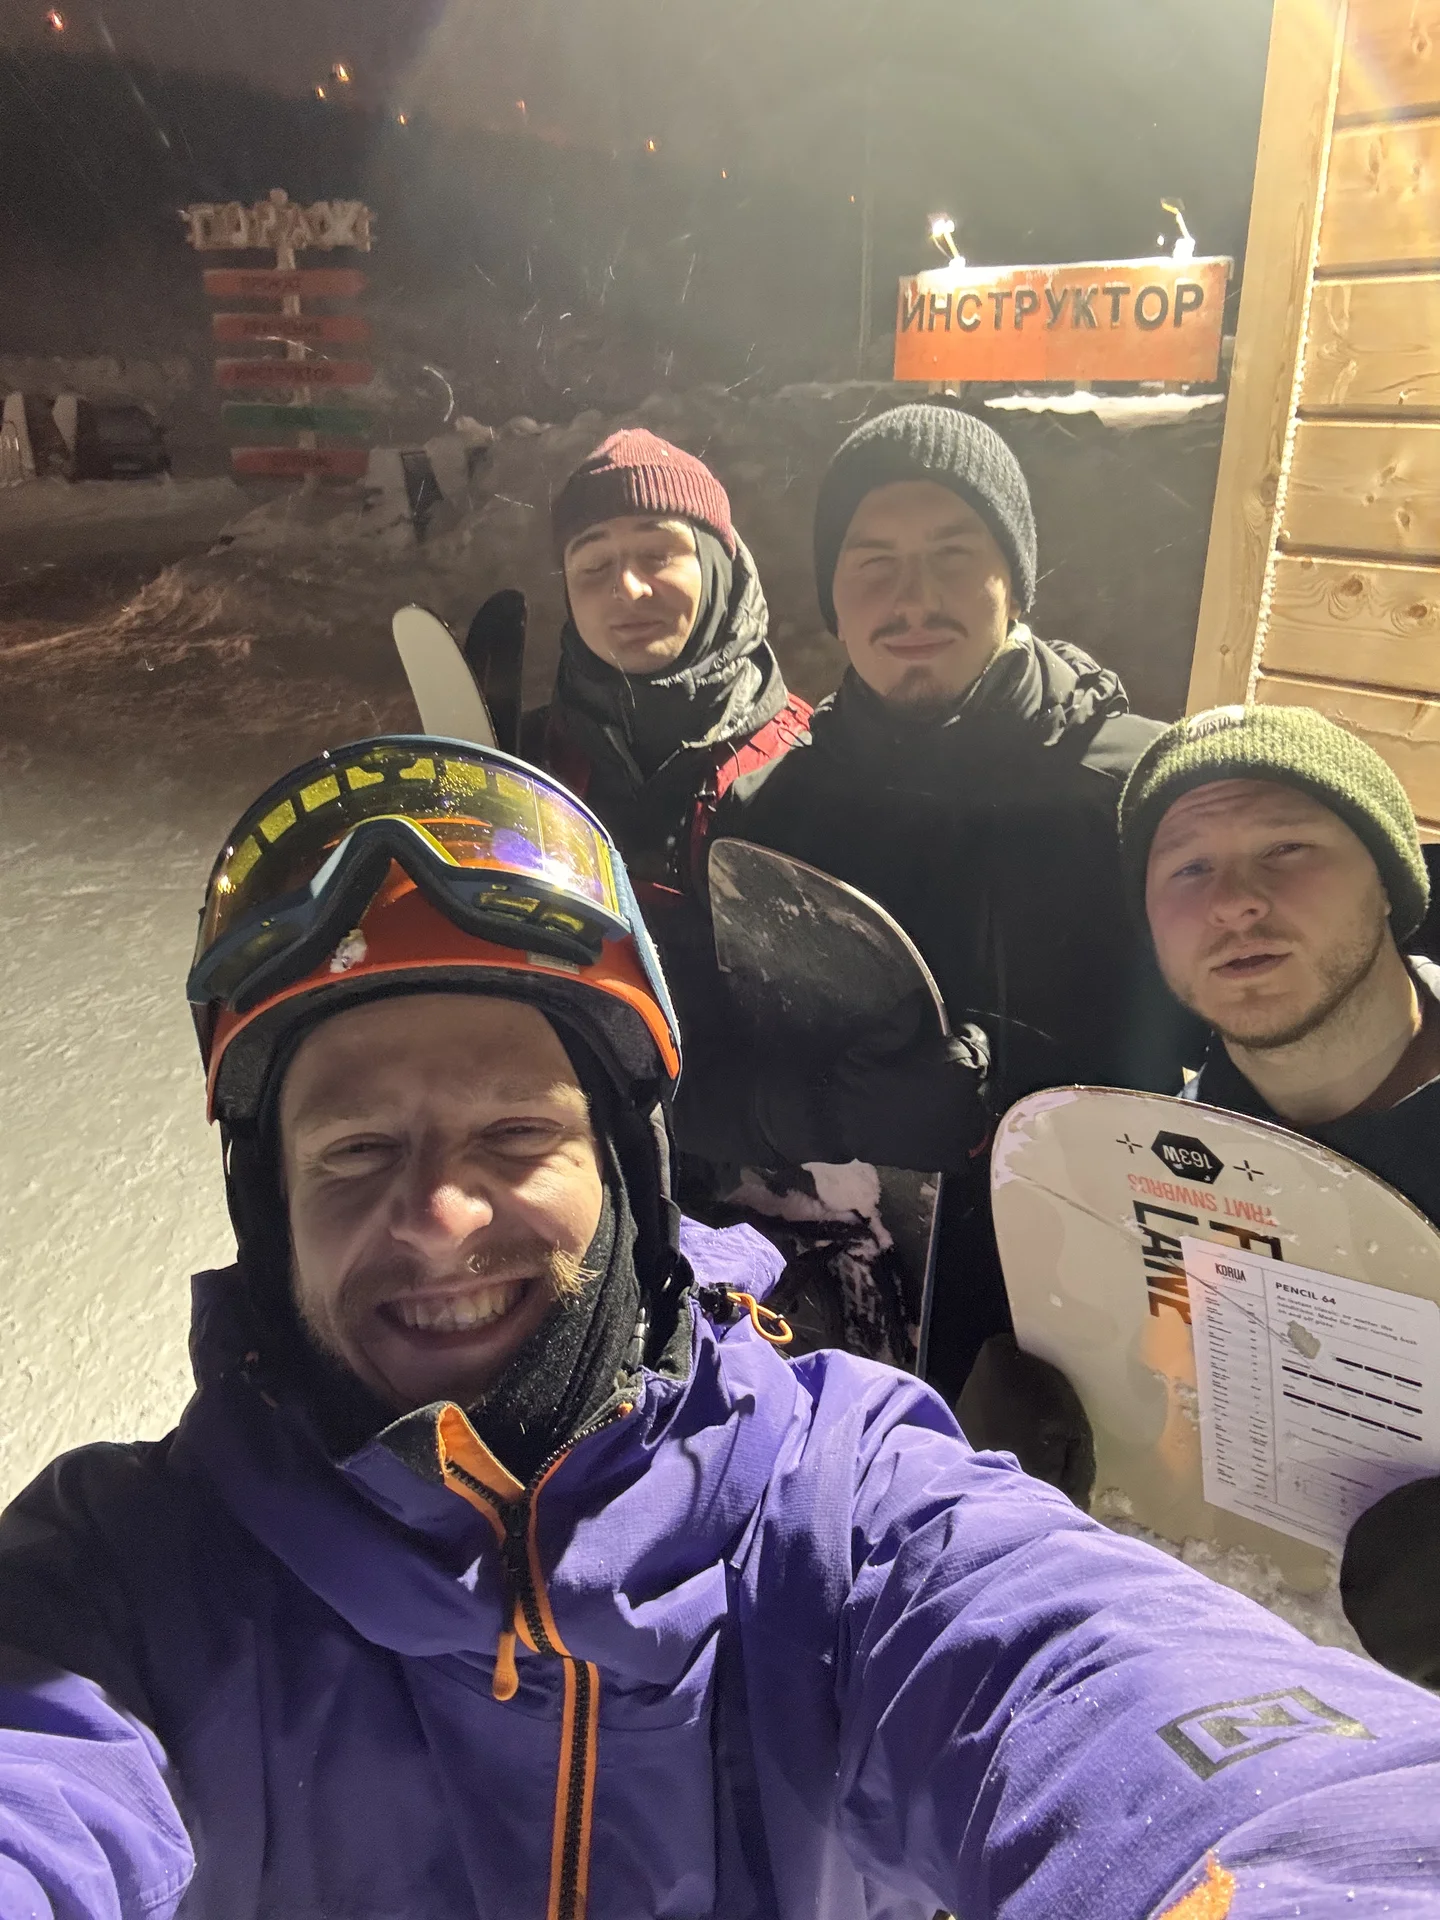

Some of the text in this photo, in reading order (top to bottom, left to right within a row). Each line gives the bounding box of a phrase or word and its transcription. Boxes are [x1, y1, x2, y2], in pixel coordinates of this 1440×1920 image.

[902, 281, 1204, 333] ИНСТРУКТОР
[1162, 1144, 1214, 1170] 163W
[1215, 1263, 1246, 1282] KORUA
[1276, 1282, 1337, 1305] PENCIL 64
